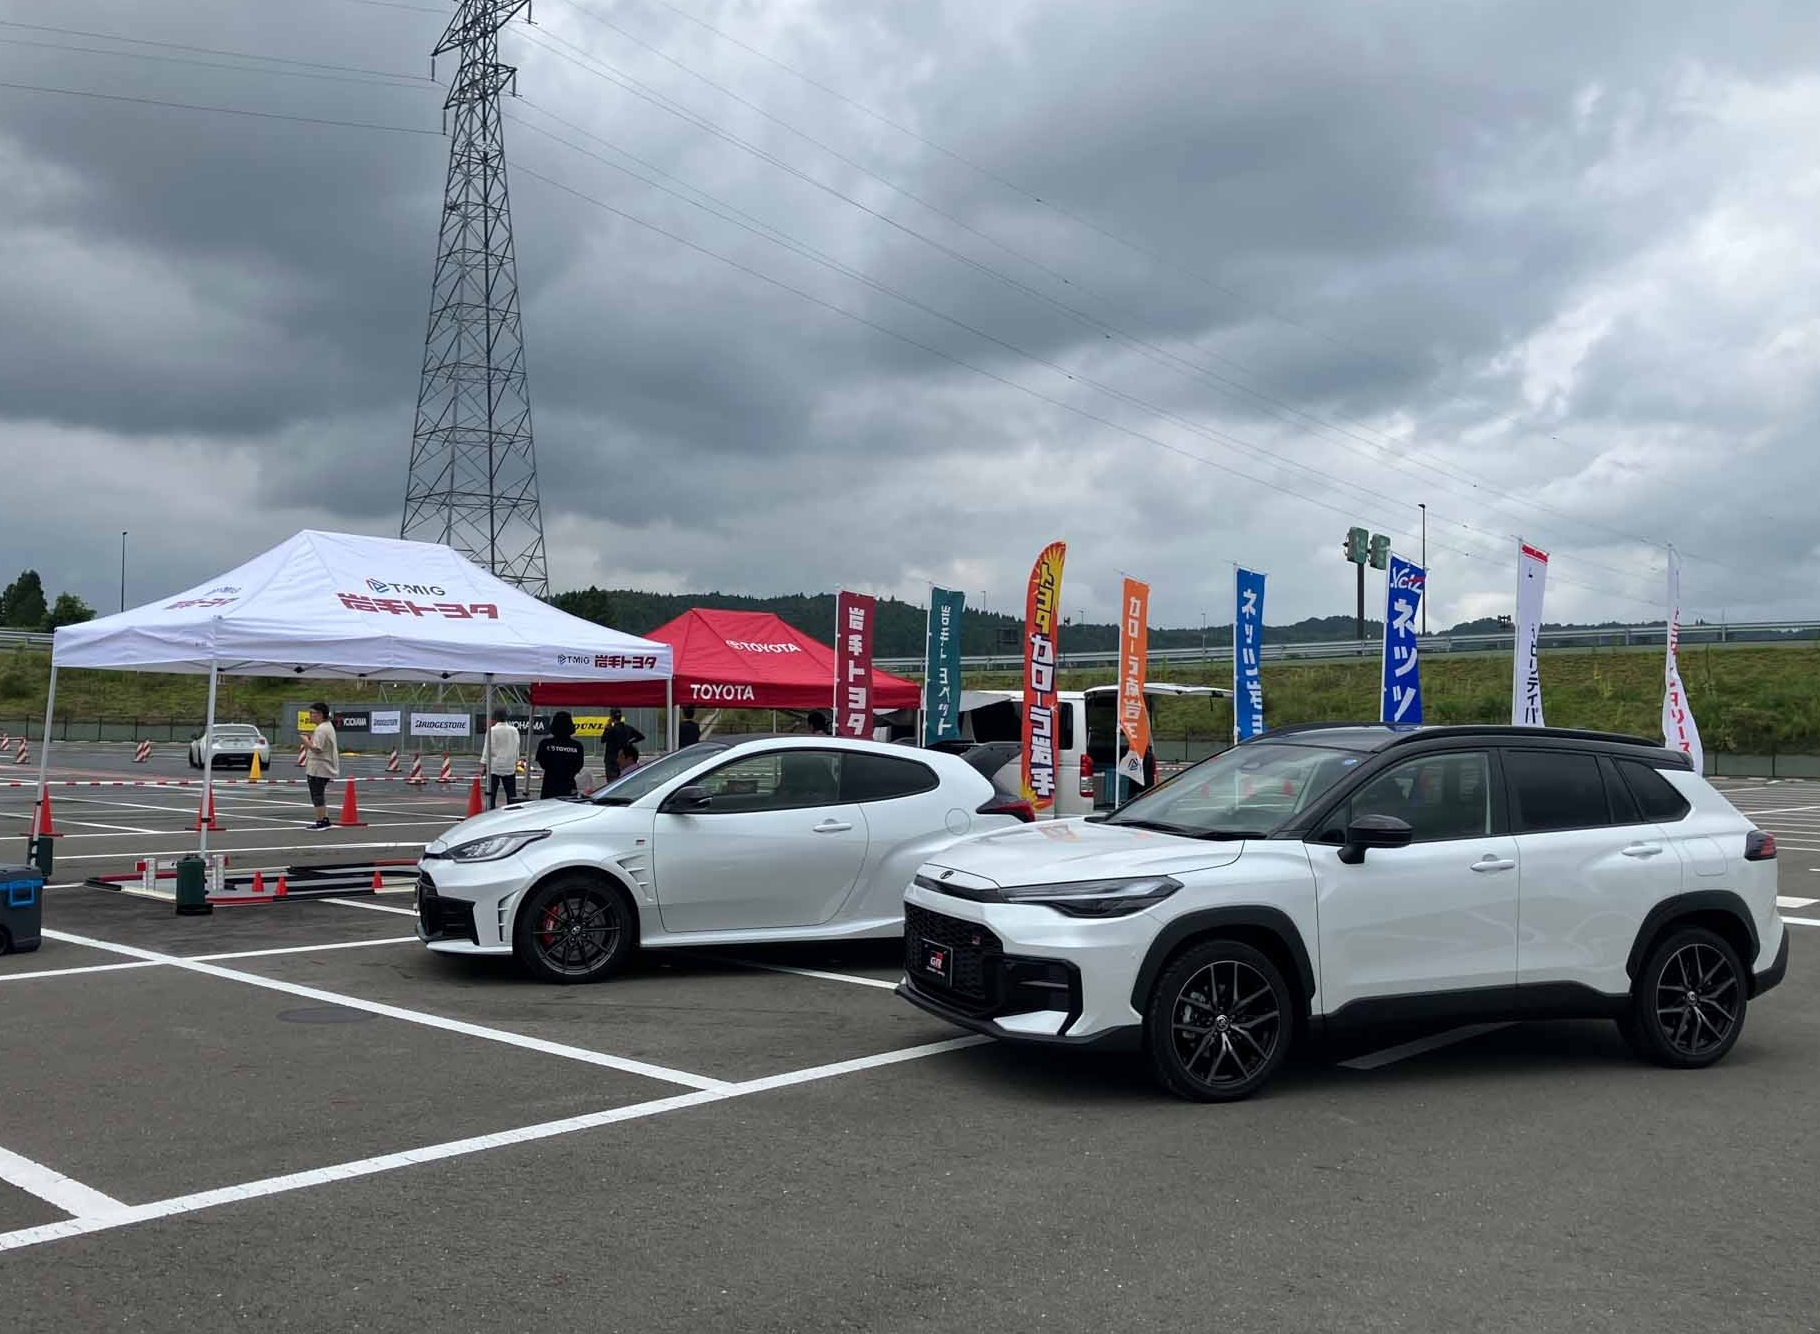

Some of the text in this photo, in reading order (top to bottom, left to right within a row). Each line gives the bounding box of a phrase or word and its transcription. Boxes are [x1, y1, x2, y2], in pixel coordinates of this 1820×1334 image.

[337, 592, 499, 619] 岩手トヨタ
[741, 642, 802, 654] TOYOTA
[594, 654, 657, 669] 岩手トヨタ
[847, 606, 867, 736] 岩手トヨタ
[690, 684, 755, 701] TOYOTA
[415, 719, 466, 729] BRIDGESTONE
